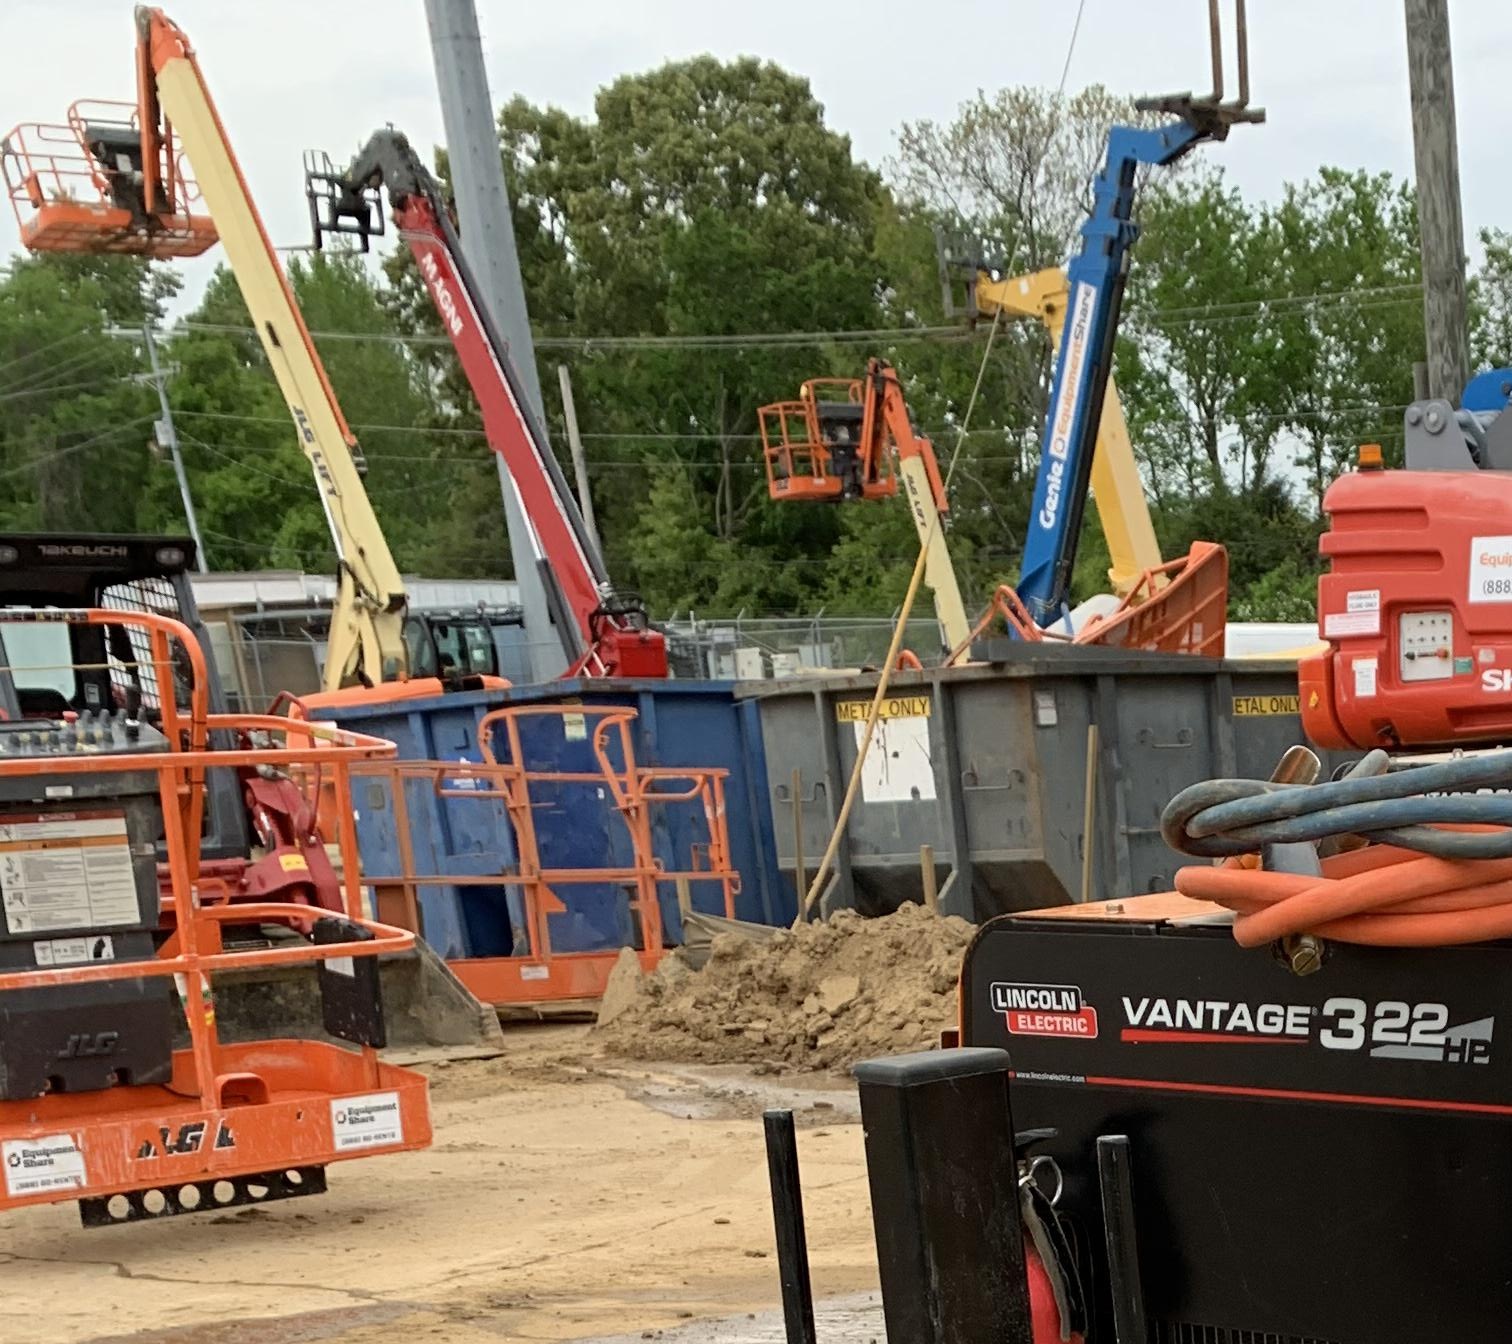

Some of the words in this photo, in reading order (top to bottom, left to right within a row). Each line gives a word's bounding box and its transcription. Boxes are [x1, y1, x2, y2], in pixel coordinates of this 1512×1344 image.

[422, 252, 463, 335] MAGNI
[1057, 289, 1092, 436] EquipmentShare
[292, 405, 315, 443] JLG
[311, 452, 338, 496] LIFT
[1039, 460, 1064, 530] Genie
[38, 545, 128, 557] TAKEUCHI
[838, 702, 885, 719] MET
[889, 699, 928, 716] ONLY
[1234, 697, 1267, 714] ETAL
[996, 987, 1077, 1011] LINCOLN
[1017, 1014, 1089, 1033] ELECTRIC
[1120, 997, 1310, 1035] VANTAGE
[1319, 997, 1449, 1050] 322
[58, 1031, 119, 1058] JLG
[1016, 1071, 1085, 1083] www.lincolnelectric.com
[347, 1103, 397, 1116] Equipment
[348, 1115, 375, 1125] Share
[22, 1146, 80, 1159] Equipmen
[23, 1158, 55, 1168] Share
